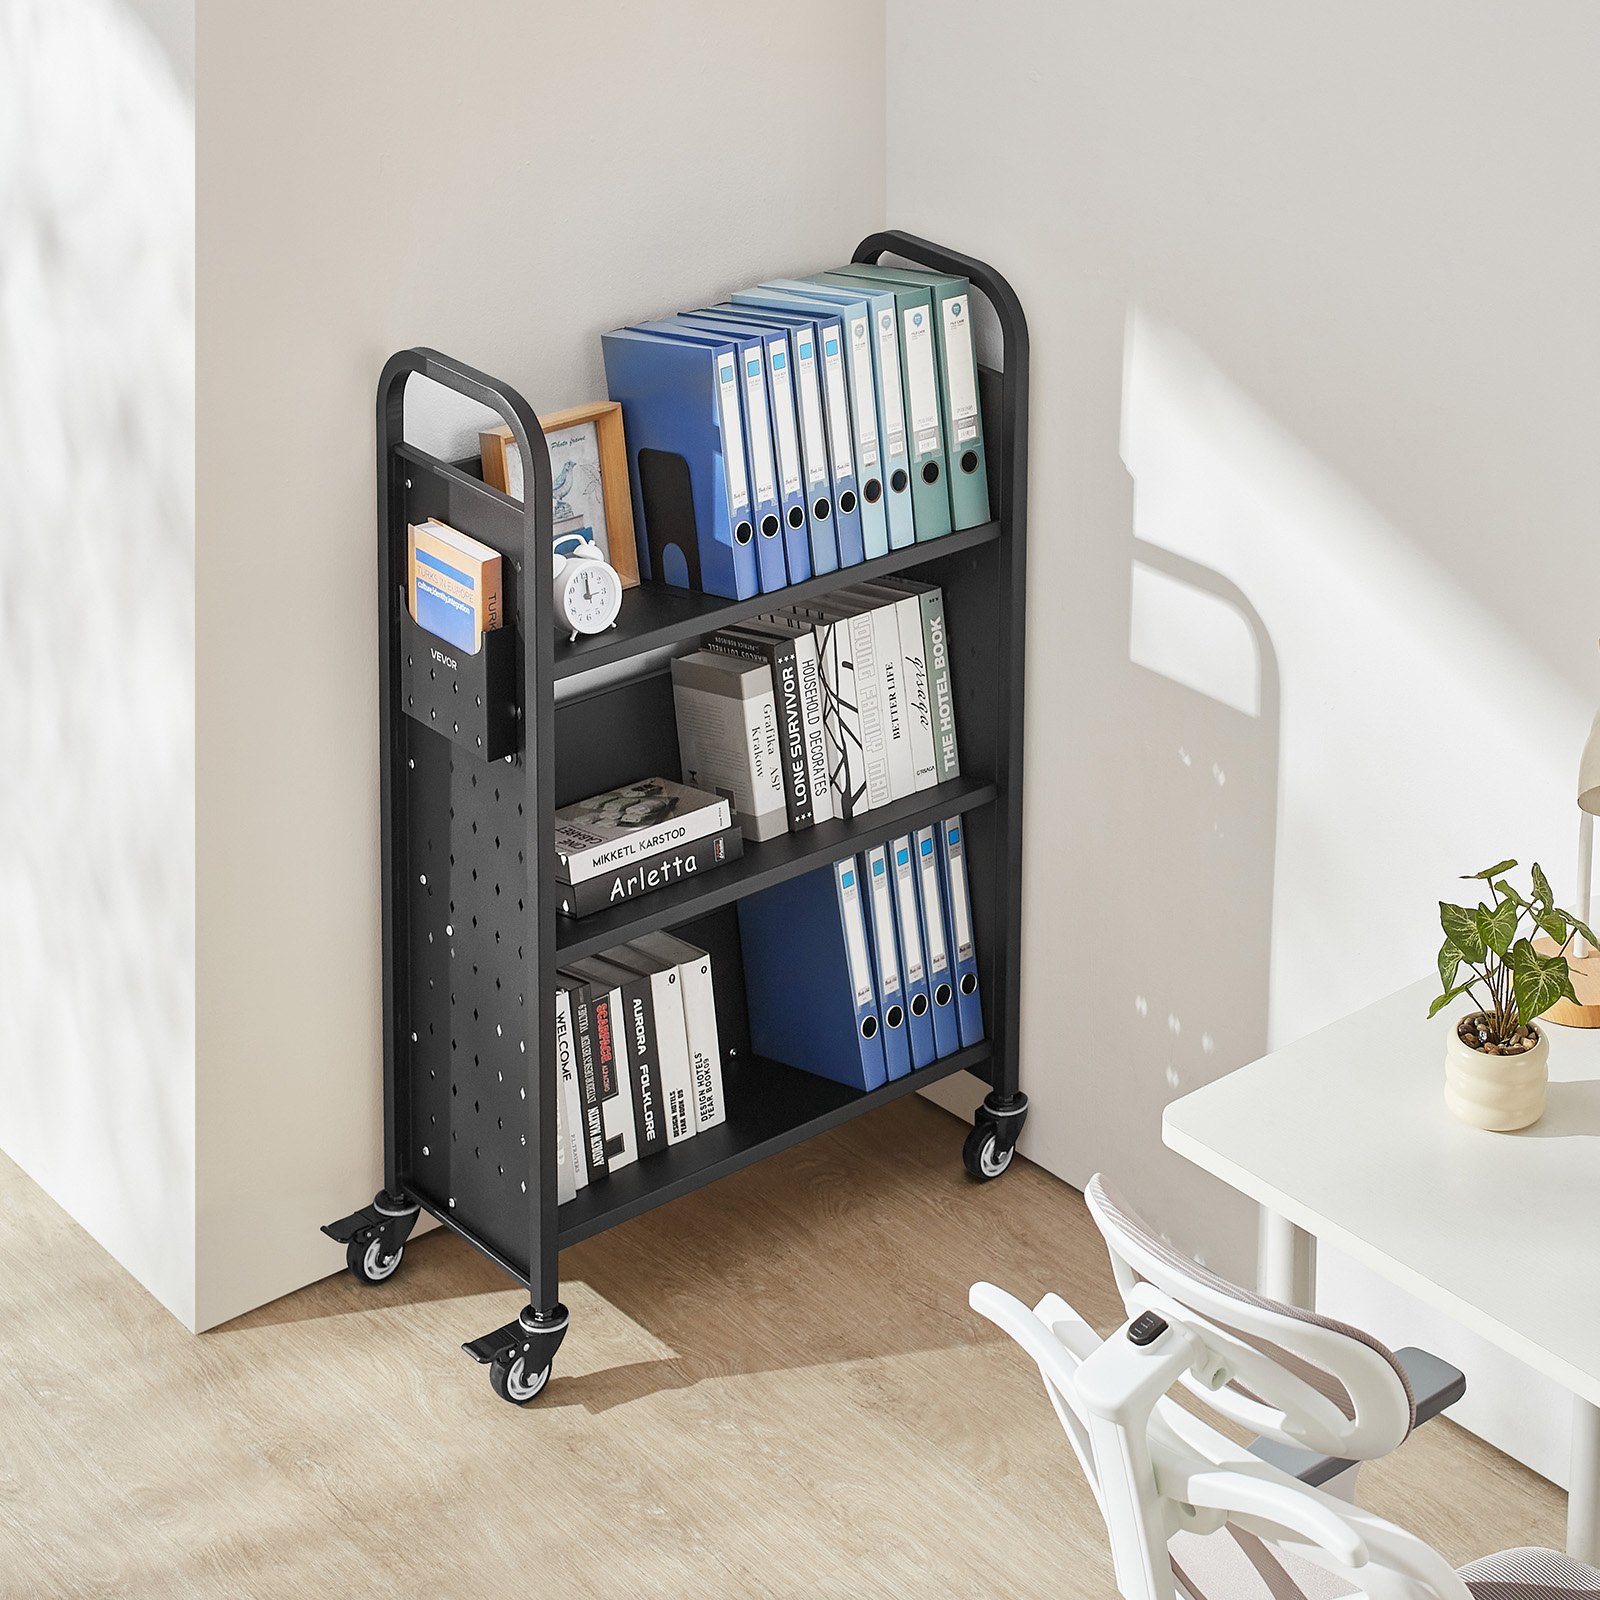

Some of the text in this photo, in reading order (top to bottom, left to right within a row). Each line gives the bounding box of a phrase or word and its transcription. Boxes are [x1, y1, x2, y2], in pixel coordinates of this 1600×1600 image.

[550, 440, 568, 450] Photo
[416, 565, 438, 584] TURKS
[446, 581, 474, 603] EUROPE
[430, 647, 457, 671] VEVOR
[930, 616, 946, 670] BOOK
[802, 658, 827, 797] HOUSEHOLD DECORATES
[884, 661, 901, 740] BETTER LIFE
[936, 670, 951, 732] HOTEL
[763, 703, 780, 791] Grafika ASP
[782, 666, 807, 806] LONE SURVIVOR
[942, 733, 956, 773] THE
[592, 844, 636, 868] MIKKETL
[638, 826, 686, 851] KARSTOD
[610, 855, 698, 902] Arletta
[556, 1010, 572, 1083] WELCOME
[596, 1003, 613, 1064] SCARFACE
[632, 998, 656, 1142] AURORA FOLKLORE
[694, 1052, 709, 1122] DESIGN HOTELS
[587, 1106, 603, 1137] MARTIN
[706, 1094, 715, 1119] YEAR
[590, 1136, 605, 1167] ANDREW
